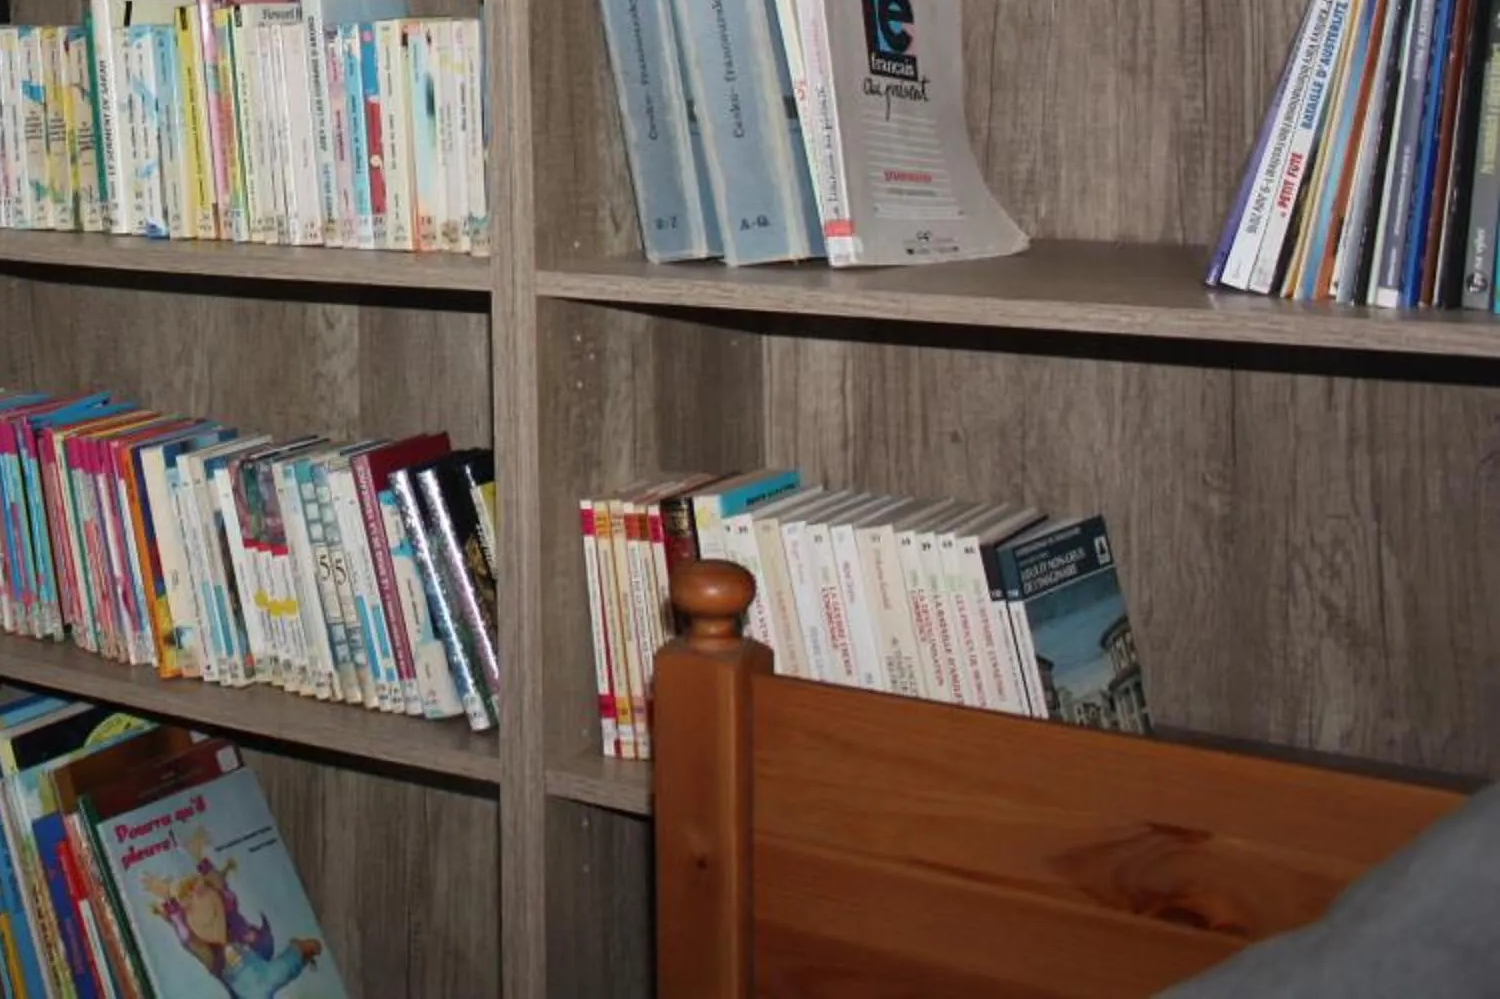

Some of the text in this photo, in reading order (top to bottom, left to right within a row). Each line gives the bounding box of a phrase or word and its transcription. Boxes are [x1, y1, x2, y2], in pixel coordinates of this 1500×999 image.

[870, 54, 917, 77] français
[1276, 179, 1294, 209] PETIT
[333, 557, 348, 586] 5
